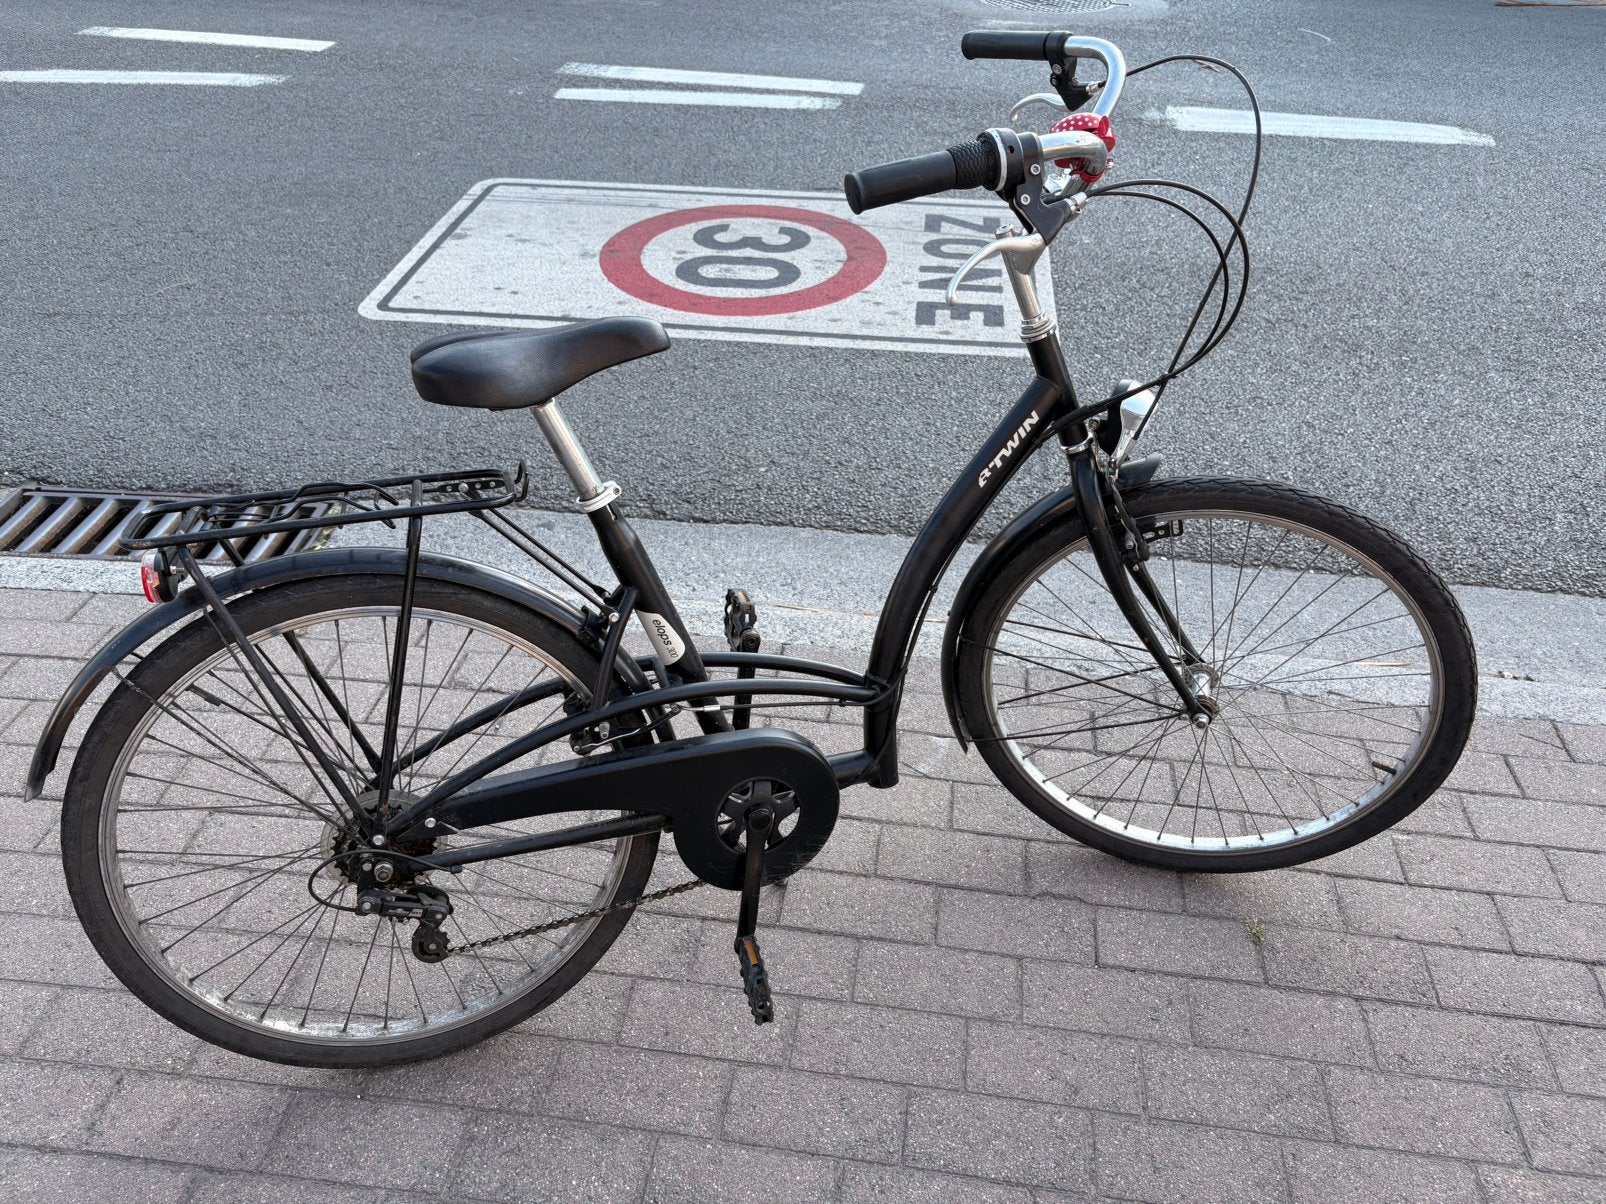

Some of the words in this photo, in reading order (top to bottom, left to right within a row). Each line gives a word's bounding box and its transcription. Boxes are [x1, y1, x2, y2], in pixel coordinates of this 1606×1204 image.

[675, 223, 812, 289] 30
[914, 213, 1005, 328] ZONE
[652, 619, 672, 646] elops
